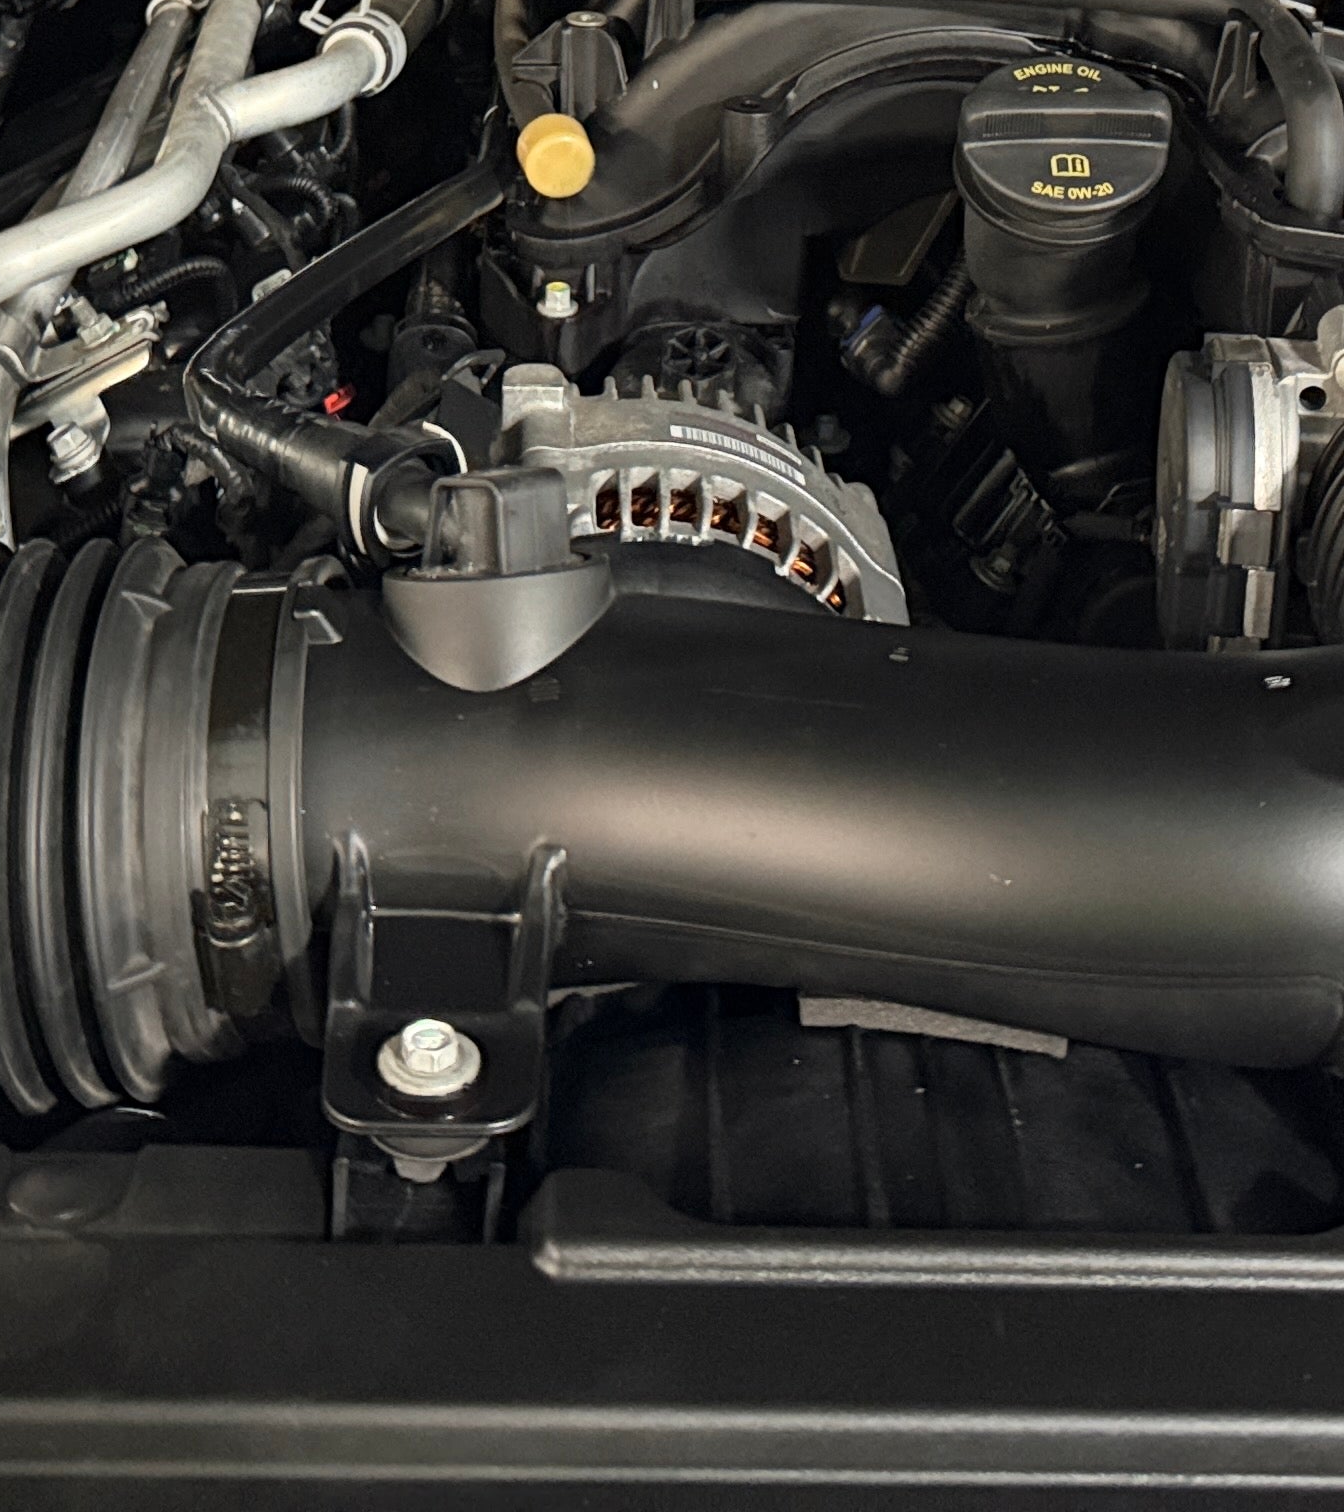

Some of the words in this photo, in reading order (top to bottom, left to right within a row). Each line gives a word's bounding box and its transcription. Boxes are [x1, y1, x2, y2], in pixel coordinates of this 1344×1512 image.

[1013, 63, 1073, 81] ENGINE
[1077, 65, 1103, 82] OIL
[1031, 181, 1065, 199] SAE
[1067, 181, 1114, 200] 0W-20
